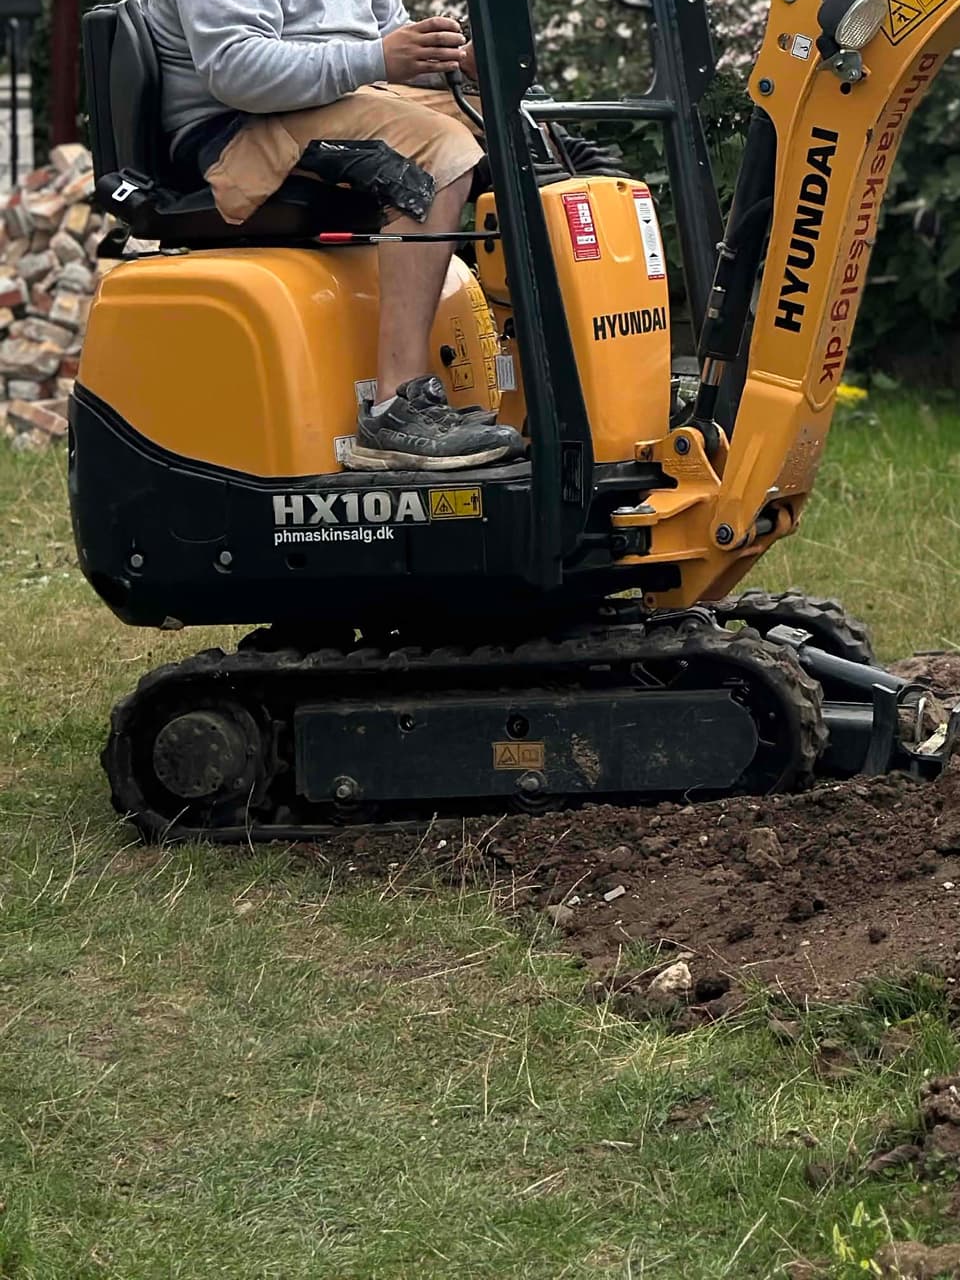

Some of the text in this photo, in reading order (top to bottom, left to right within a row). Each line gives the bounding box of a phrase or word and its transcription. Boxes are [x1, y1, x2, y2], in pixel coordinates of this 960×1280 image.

[774, 126, 839, 333] HYUNDAI
[819, 53, 939, 385] phmaskinsalg.dk
[592, 306, 667, 341] HYUNDAI
[272, 491, 427, 525] HX10A
[274, 526, 394, 546] phmaskinsalg.dk
